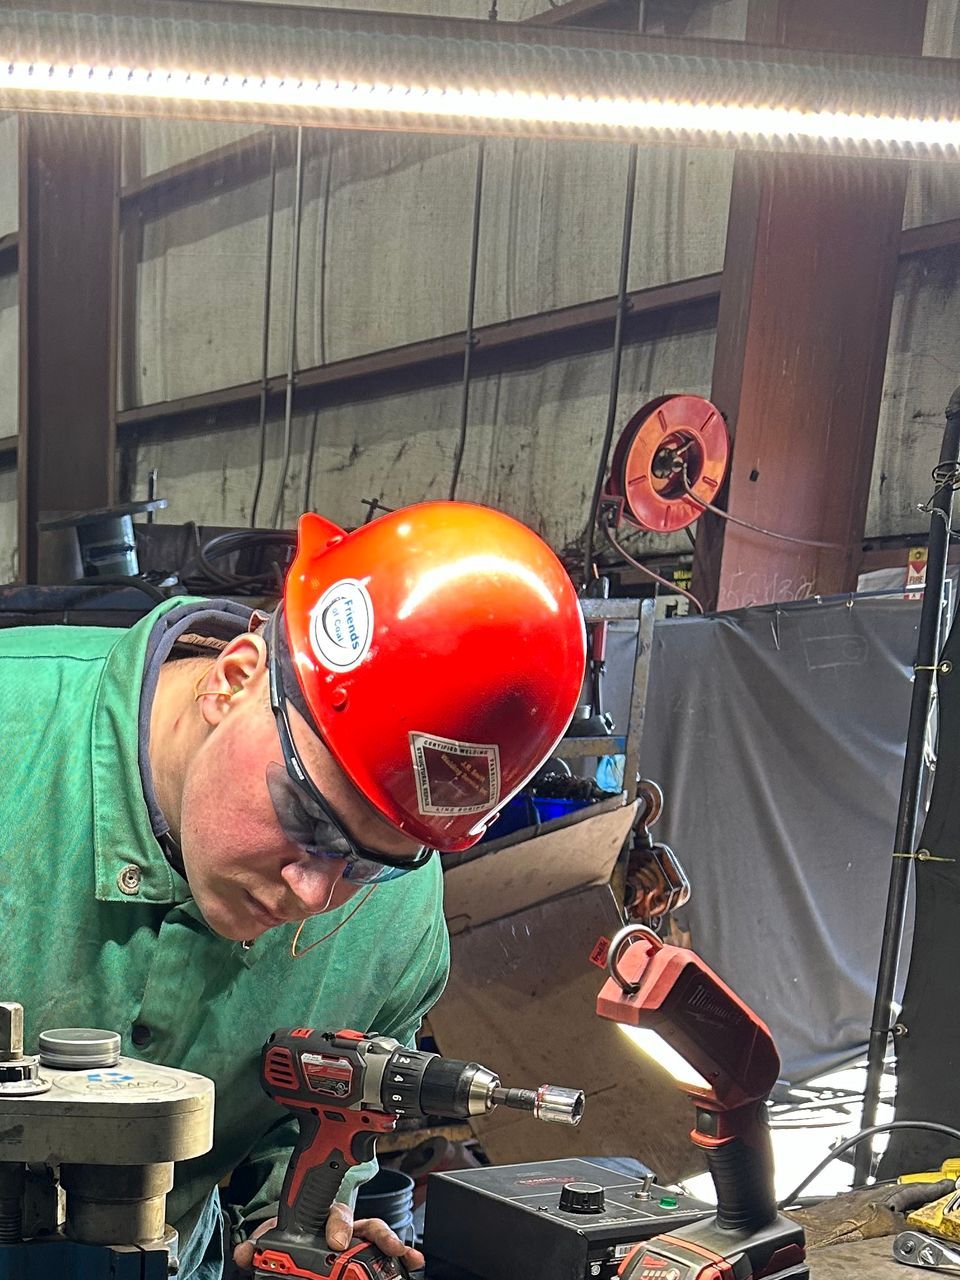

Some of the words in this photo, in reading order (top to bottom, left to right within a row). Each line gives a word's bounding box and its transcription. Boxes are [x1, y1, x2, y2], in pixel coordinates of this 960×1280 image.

[909, 575, 924, 584] FIRE
[332, 608, 339, 618] of
[344, 599, 360, 651] Friends
[333, 619, 345, 644] Coal
[424, 740, 458, 753] CERTIFIED
[459, 748, 488, 756] WELDING
[416, 747, 427, 787] STRUCTURAL
[399, 1056, 410, 1064] 2
[393, 1074, 404, 1082] 4
[392, 1094, 402, 1102] 6
